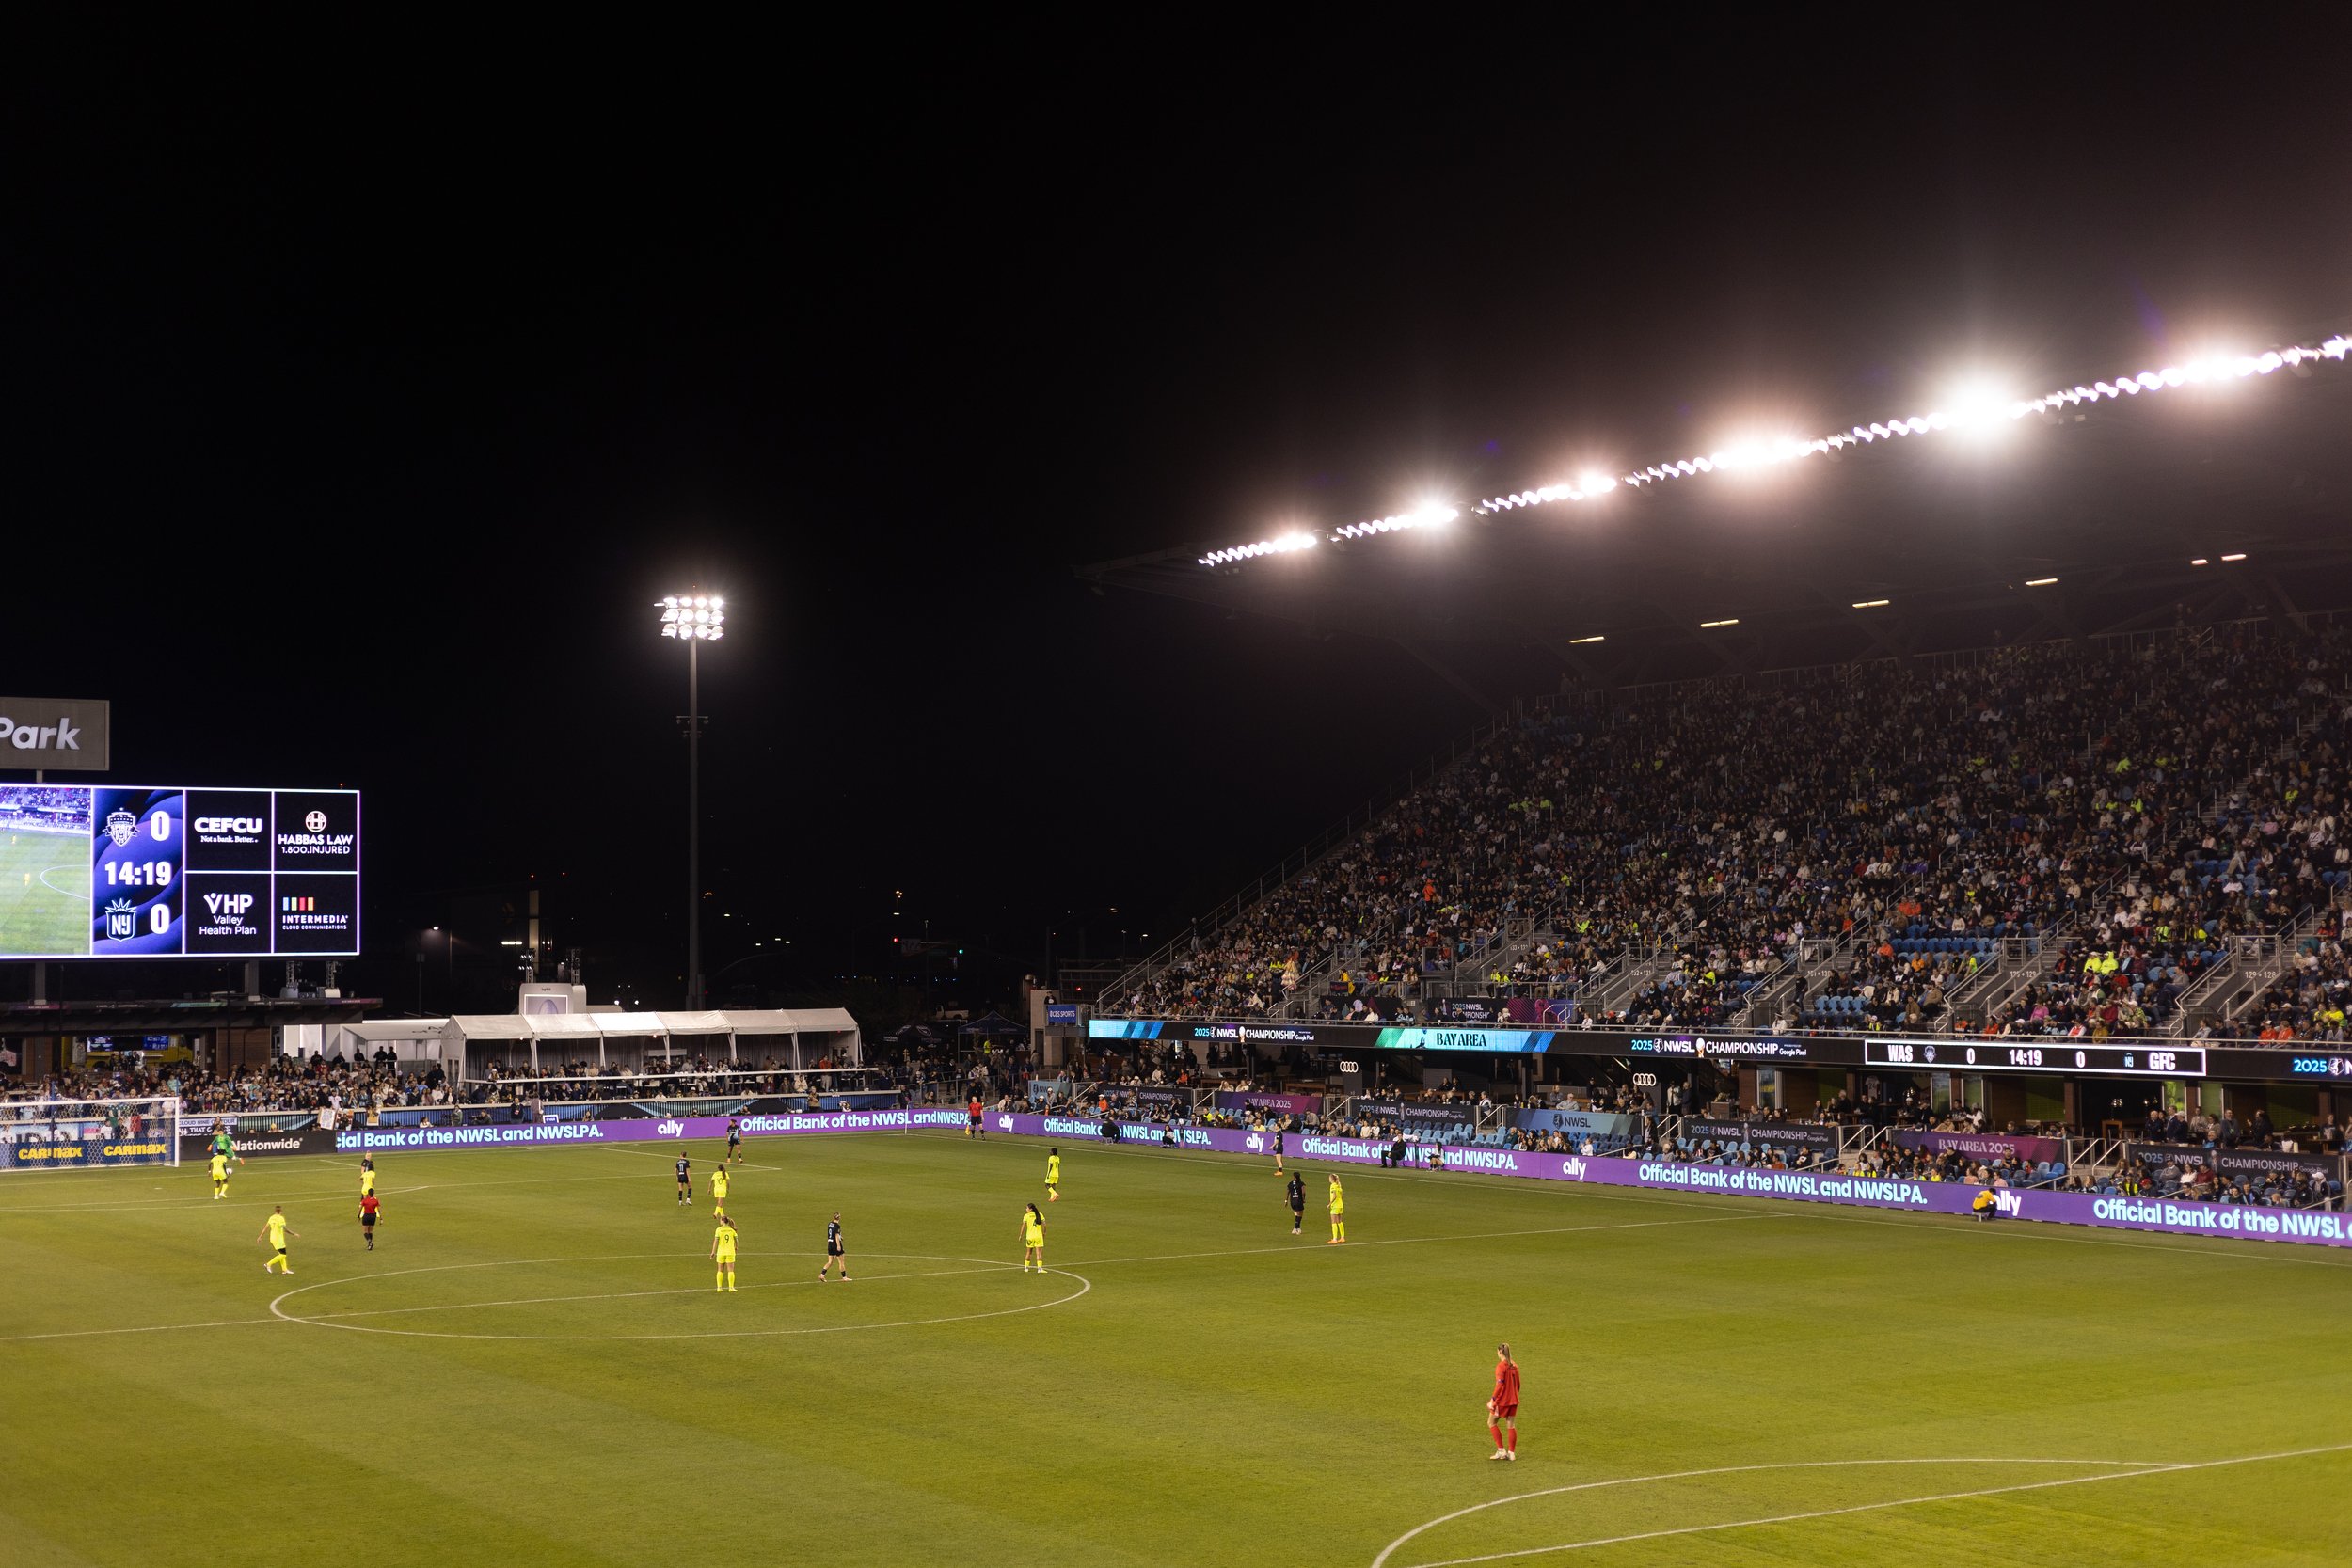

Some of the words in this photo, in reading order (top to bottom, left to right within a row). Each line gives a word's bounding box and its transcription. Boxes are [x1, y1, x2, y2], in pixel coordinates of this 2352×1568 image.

[151, 810, 170, 842] 0
[194, 817, 263, 833] CEFCU
[278, 834, 325, 846] HABBAS
[327, 834, 354, 846] LAW
[281, 846, 351, 855] 1.800.INJURED
[104, 861, 172, 886] 14:19
[203, 893, 254, 914] VHP
[111, 914, 131, 935] NY
[151, 903, 170, 935] 0
[213, 915, 244, 926] Valley
[199, 926, 232, 935] Health
[235, 926, 257, 935] Plan
[1059, 1009, 1075, 1018] SPORTS
[1194, 1027, 1210, 1037] 2025
[1216, 1028, 1239, 1038] NWSL
[1245, 1029, 1295, 1040] CHAMPIONSHIP
[1436, 1033, 1458, 1046] BAY
[1458, 1033, 1487, 1047] AREA
[1630, 1039, 1653, 1051] 2025
[1663, 1040, 1695, 1053] NWSL
[1705, 1041, 1779, 1055] CHAMPIONSHIP
[1779, 1048, 1795, 1057] Google
[1795, 1048, 1807, 1056] Pixel
[1887, 1044, 1914, 1063] WAS
[1966, 1047, 1976, 1065] 0
[2009, 1049, 2042, 1067] 14:19
[2075, 1051, 2086, 1069] 0
[2149, 1052, 2176, 1071] GFC
[2293, 1059, 2328, 1073] 2025
[1275, 1100, 1292, 1109] 2025
[1380, 1106, 1399, 1116] NWSL
[1406, 1107, 1450, 1119] CHAMPIONSHIP
[657, 1119, 685, 1137] ally
[740, 1116, 790, 1132] Official
[792, 1115, 830, 1130] Bank
[832, 1114, 849, 1129] of
[848, 1114, 870, 1127] the
[872, 1112, 912, 1127] NWSL
[913, 1110, 937, 1125] and
[998, 1114, 1014, 1132] ally
[1044, 1118, 1074, 1133] Official
[1074, 1120, 1097, 1136] Bank
[1564, 1117, 1592, 1129] NWSL
[363, 1130, 406, 1147] Bank
[407, 1129, 425, 1145] of
[426, 1129, 453, 1144] the
[455, 1128, 501, 1144] NWSL
[502, 1126, 534, 1142] and
[536, 1124, 604, 1140] NWSLPA.
[1122, 1125, 1150, 1140] NWSL
[1691, 1125, 1709, 1134] 2025
[1717, 1127, 1742, 1137] NWSL
[1751, 1128, 1808, 1141] CHAMPIONSHIP
[231, 1137, 301, 1152] Nationwide
[1246, 1132, 1264, 1153] ally
[1302, 1137, 1342, 1156] Official
[1341, 1140, 1370, 1159] Bank
[1369, 1144, 1383, 1159] of
[1938, 1139, 1964, 1151] BAY
[1964, 1140, 1988, 1153] AREA
[1464, 1150, 1518, 1171] NWSLPA.
[1562, 1157, 1587, 1180] ally
[2221, 1157, 2299, 1172] CHAMPIONSHIP
[1639, 1164, 1689, 1184] Official
[1690, 1168, 1729, 1189] Bank
[1729, 1169, 1746, 1189] of
[1745, 1171, 1772, 1191] the
[1774, 1174, 1819, 1196] NWSL
[1820, 1180, 1852, 1197] and
[1853, 1180, 1928, 1205] NWSLPA.
[2093, 1197, 2162, 1224] Official
[2165, 1203, 2218, 1228] Bank
[2219, 1207, 2241, 1230] of
[2243, 1210, 2280, 1234] the
[2281, 1212, 2345, 1239] NWSL
